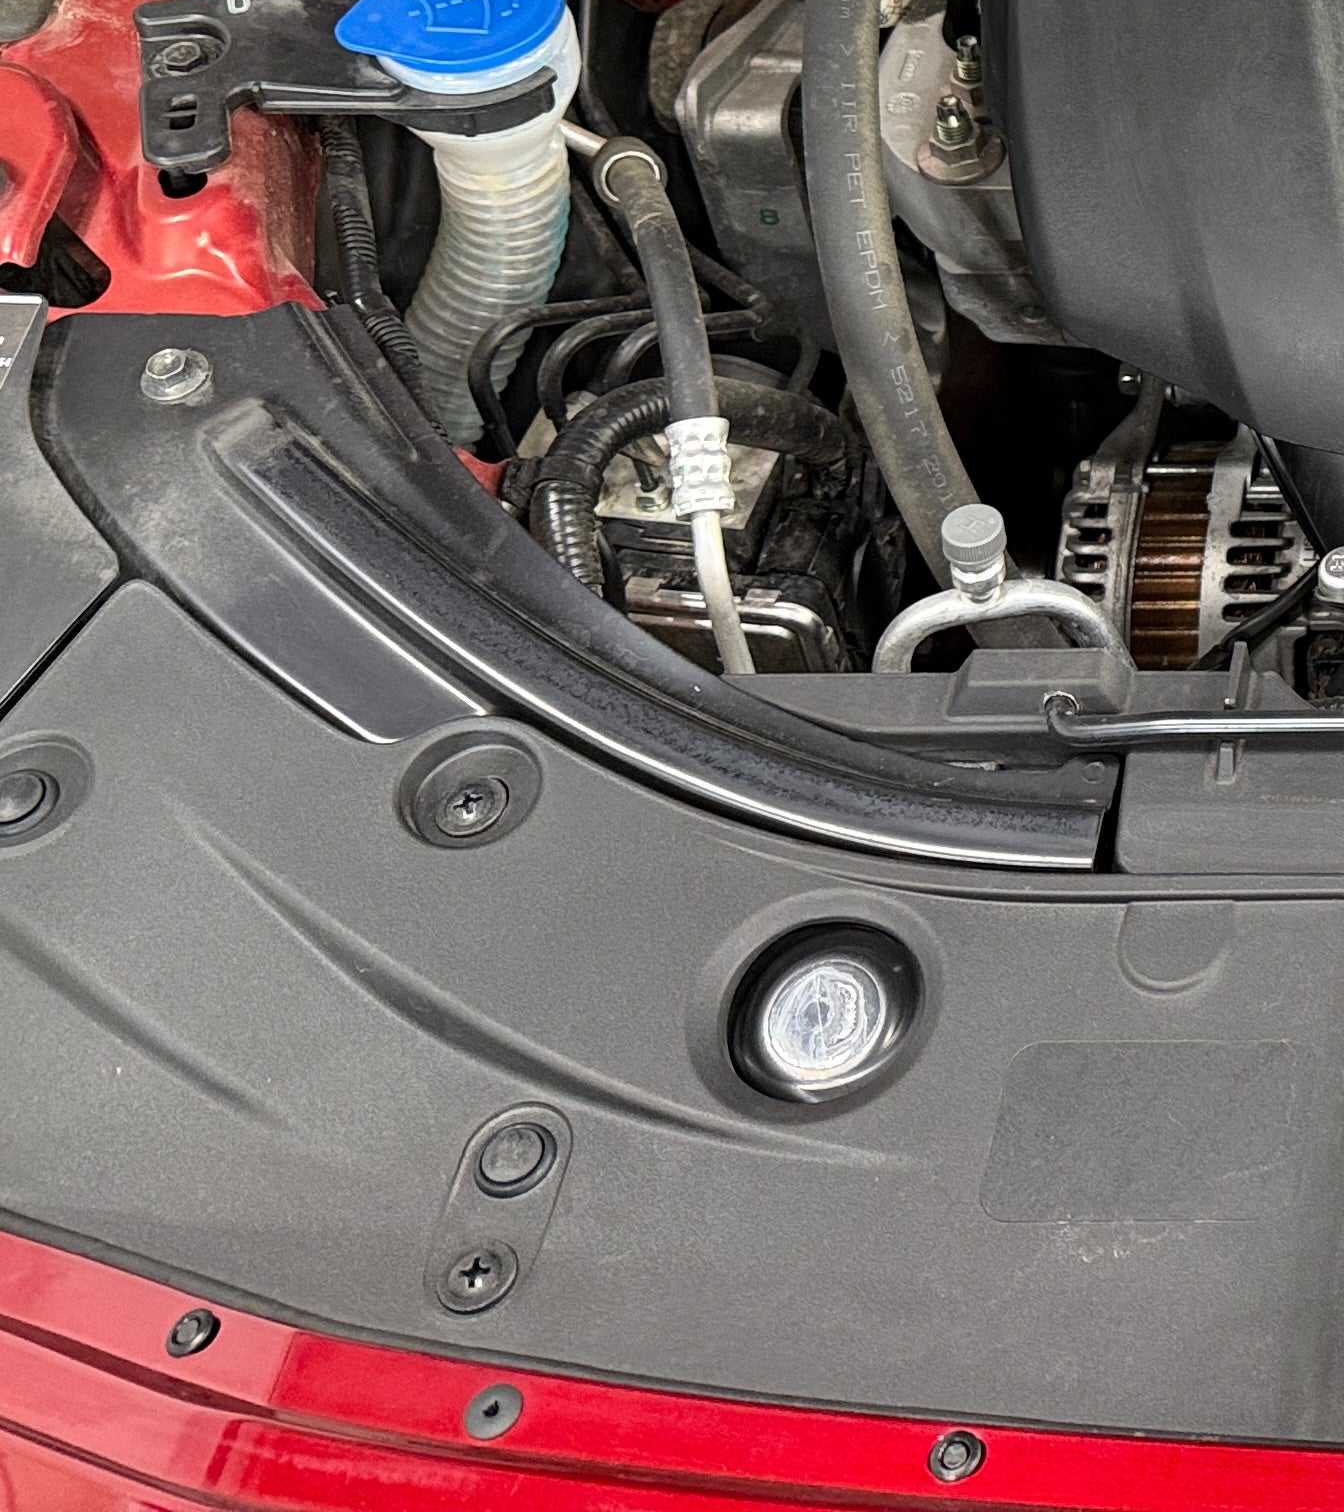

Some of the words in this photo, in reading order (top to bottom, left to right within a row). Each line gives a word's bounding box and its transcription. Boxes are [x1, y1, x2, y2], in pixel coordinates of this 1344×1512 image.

[844, 153, 867, 208] PET
[856, 230, 888, 310] EPDM
[890, 364, 928, 437] 5217
